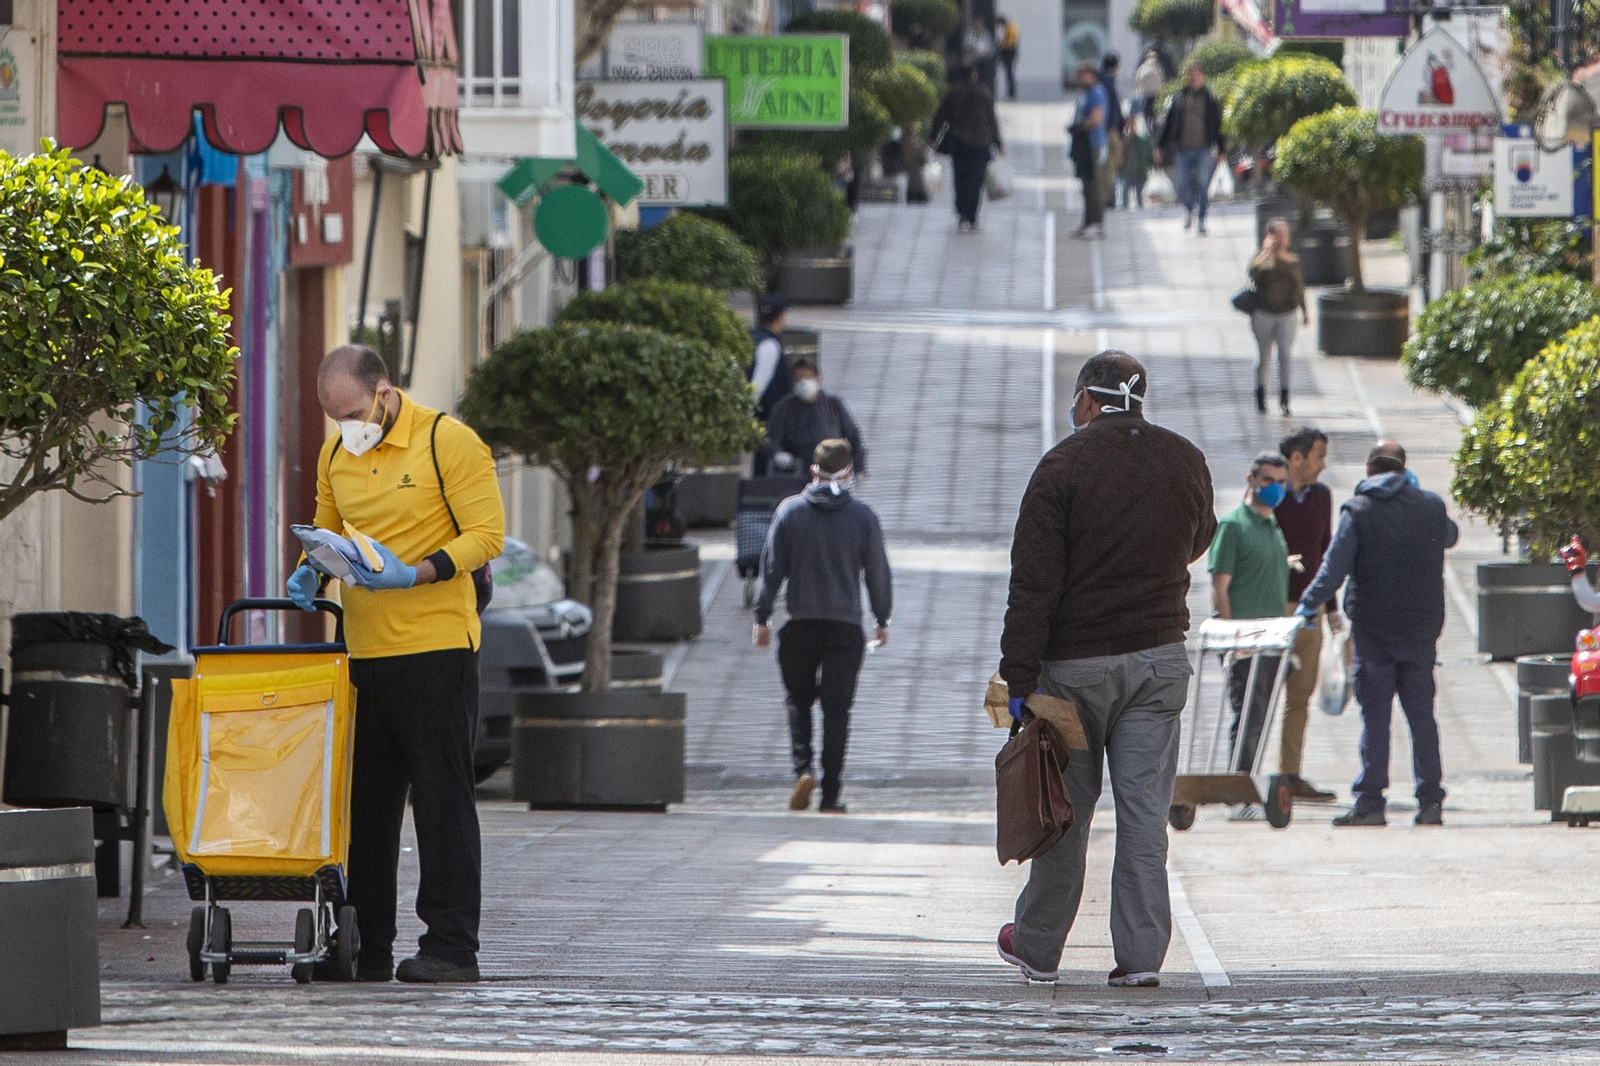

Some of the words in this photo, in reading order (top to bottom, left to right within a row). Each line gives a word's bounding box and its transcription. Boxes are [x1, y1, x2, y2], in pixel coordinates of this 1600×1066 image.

[706, 43, 837, 77] UTERIA
[1380, 108, 1499, 131] Cruzcampo
[638, 173, 679, 200] ER
